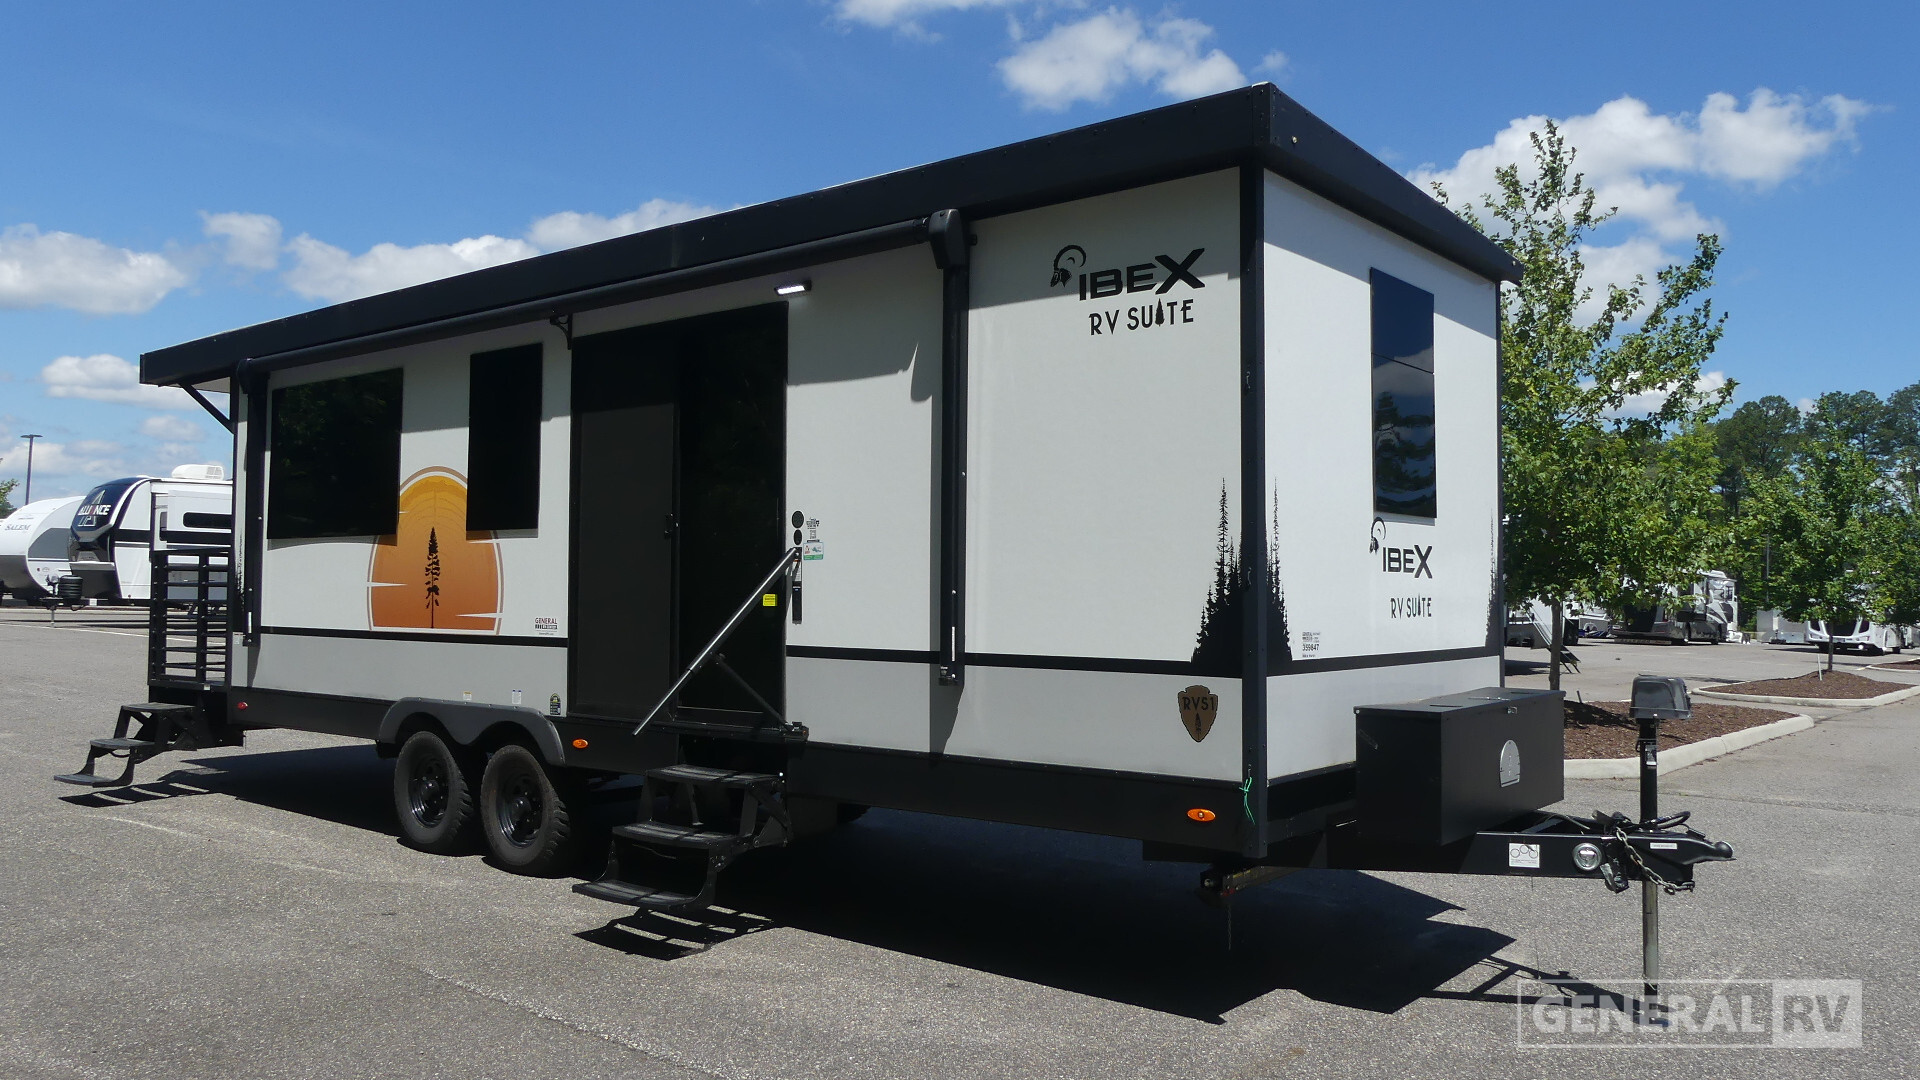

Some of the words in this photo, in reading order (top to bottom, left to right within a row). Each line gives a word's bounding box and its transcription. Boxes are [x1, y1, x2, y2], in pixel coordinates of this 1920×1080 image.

[1079, 248, 1205, 301] IBEX
[1089, 309, 1120, 336] RV
[1126, 298, 1194, 331] SUITE
[78, 504, 112, 516] ALLIANCE
[1382, 544, 1433, 579] IBEX
[1390, 597, 1404, 620] RV
